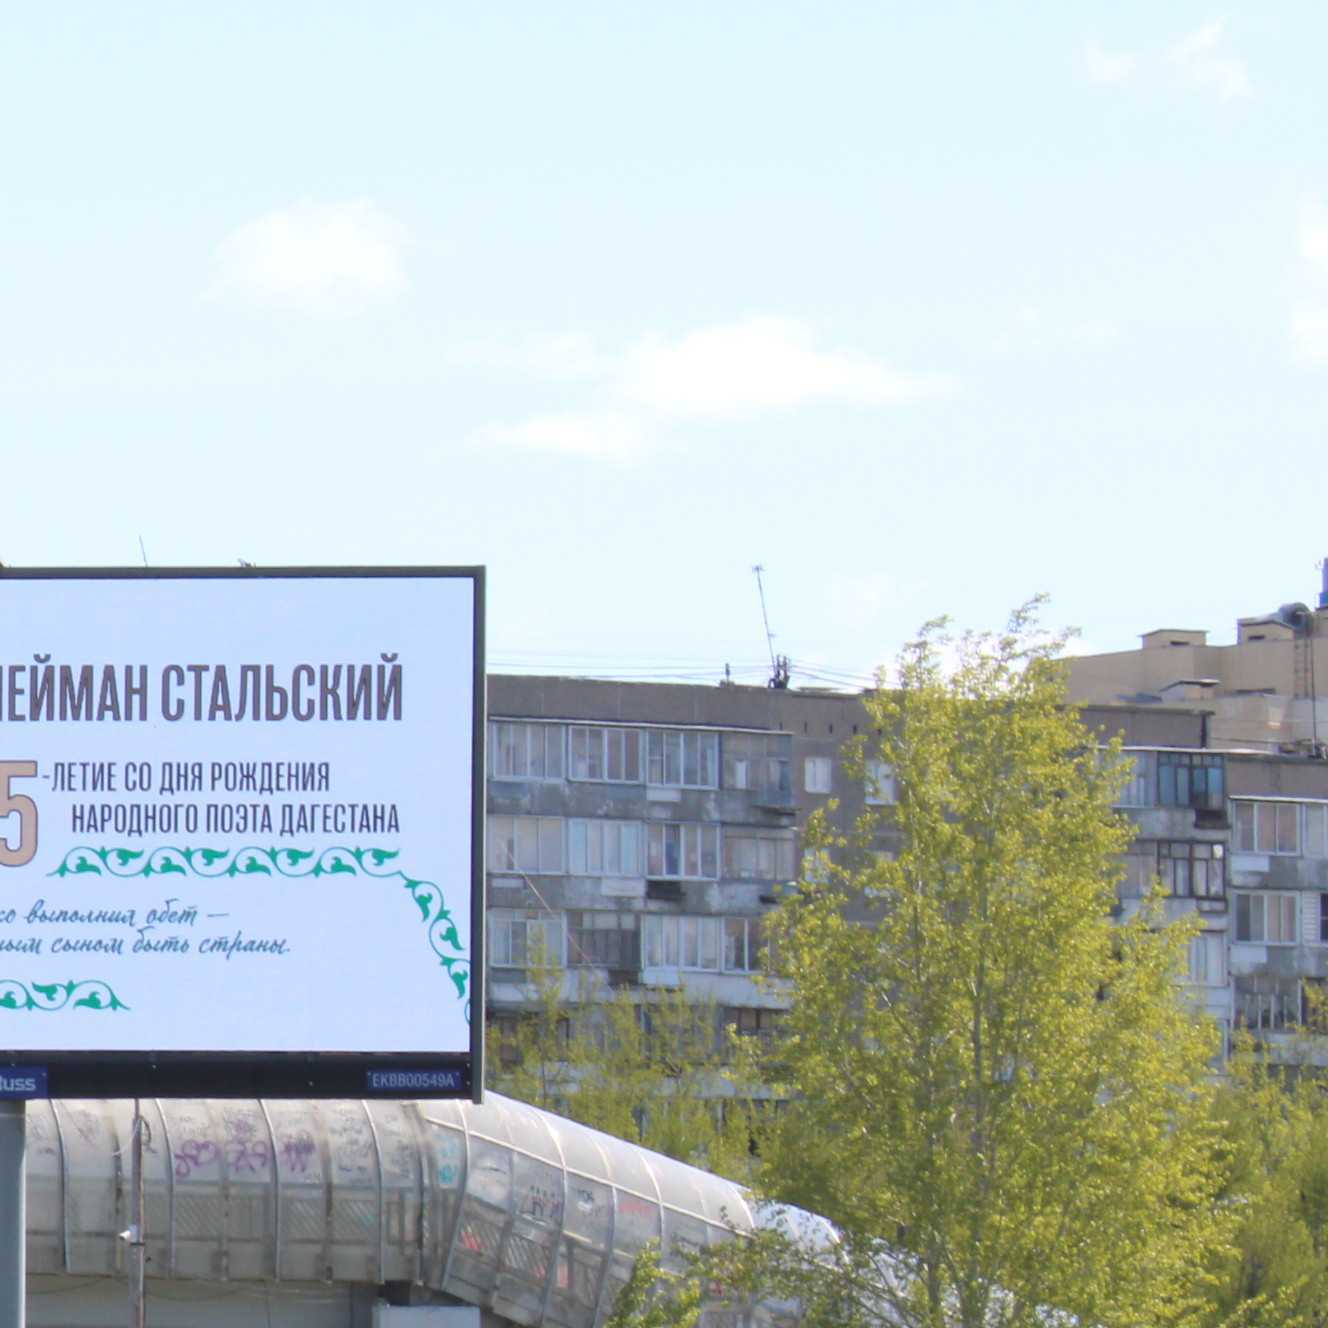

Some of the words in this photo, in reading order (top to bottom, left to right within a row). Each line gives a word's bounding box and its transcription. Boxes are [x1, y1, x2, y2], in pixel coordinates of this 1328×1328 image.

[161, 653, 403, 722] СТАЛЬСКИЙ
[124, 761, 152, 792] СО
[159, 761, 203, 795] ДНЯ
[210, 761, 330, 795] РОЖДЕНИЯ
[72, 803, 198, 837] НАРОДНОГО
[206, 803, 273, 834] ПОЭТА
[279, 803, 400, 838] ДАГЕСТАНА
[24, 899, 136, 927] выполнил
[146, 898, 198, 926] обет
[51, 937, 124, 955] сыном
[132, 925, 190, 954] быть
